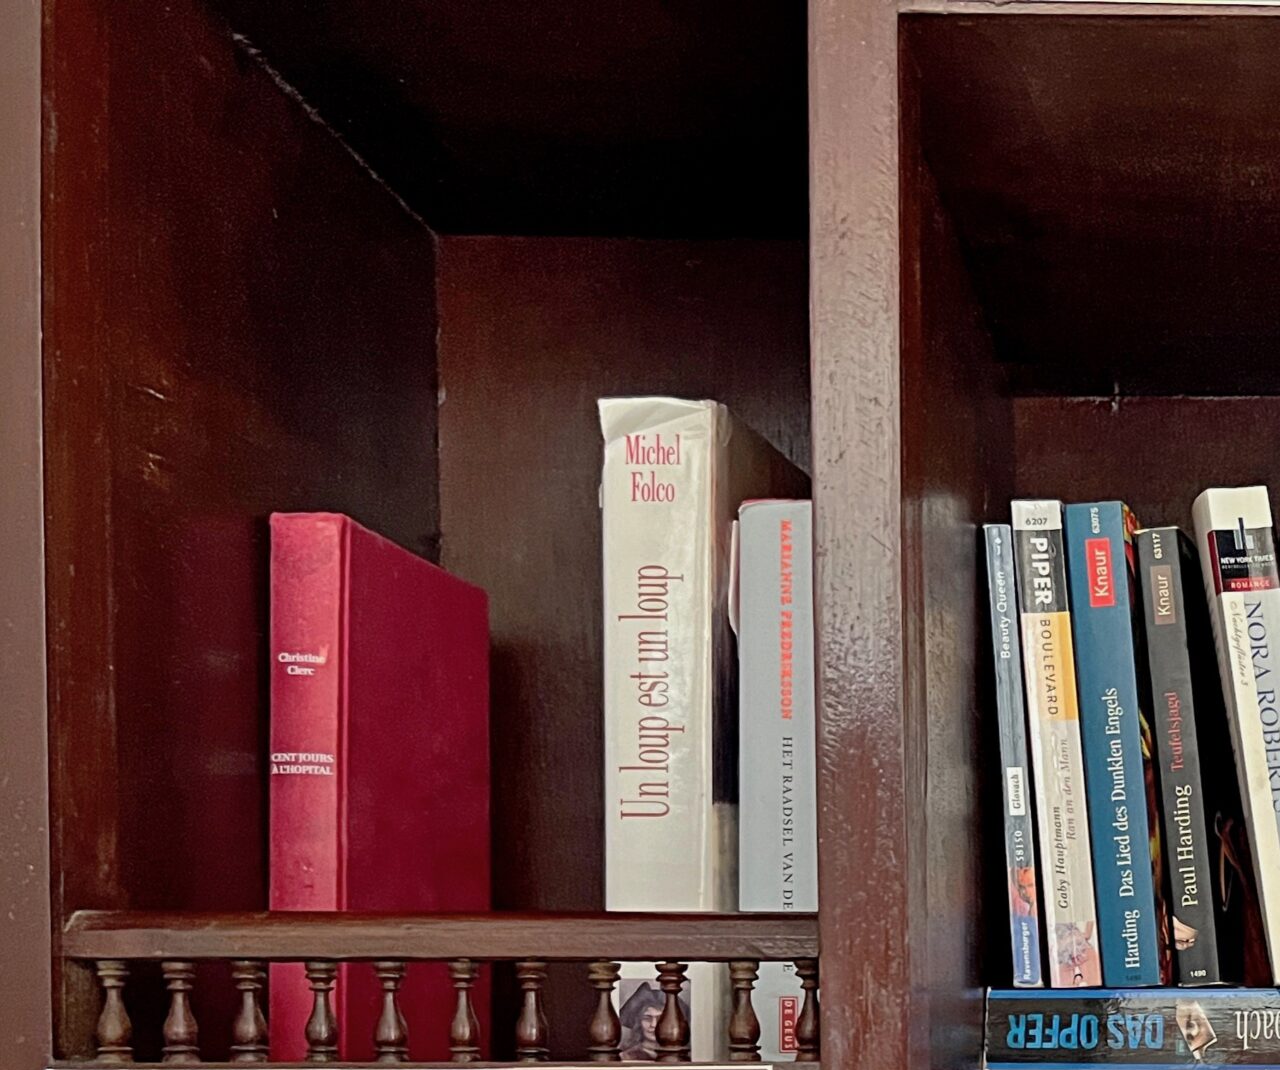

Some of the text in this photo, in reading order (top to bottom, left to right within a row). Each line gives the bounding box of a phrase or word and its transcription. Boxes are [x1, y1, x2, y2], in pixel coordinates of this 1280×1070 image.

[625, 434, 681, 465] Michel
[631, 471, 676, 502] Folco
[1025, 517, 1048, 526] 6207
[1030, 537, 1053, 605] PIPER
[1094, 548, 1110, 597] Knaur
[1157, 575, 1171, 616] Knaur
[1230, 580, 1270, 589] ROMANCE
[997, 571, 1012, 659] Beauty Queen
[1245, 600, 1271, 680] NORA
[278, 652, 327, 665] Christine
[286, 665, 316, 676] Clerc
[1039, 619, 1059, 715] BOULEVARD
[618, 565, 684, 820] Un loup est un loup
[780, 519, 794, 910] MARIANNE HET RAADSEL VAN DE
[271, 753, 334, 763] CENT JOURS
[1060, 738, 1077, 841] Ran an den Mann
[1163, 692, 1198, 906] Paul Harding Teufelsjagd
[1014, 830, 1025, 862] 58150
[1101, 687, 1140, 968] Harding Das Lied des Dunklen Engels
[1053, 806, 1069, 909] Gaby Hauptmann
[1021, 922, 1032, 980] Ravensburger
[783, 1000, 794, 1050] DE GEUS
[1006, 1014, 1164, 1050] DAS OPFER
